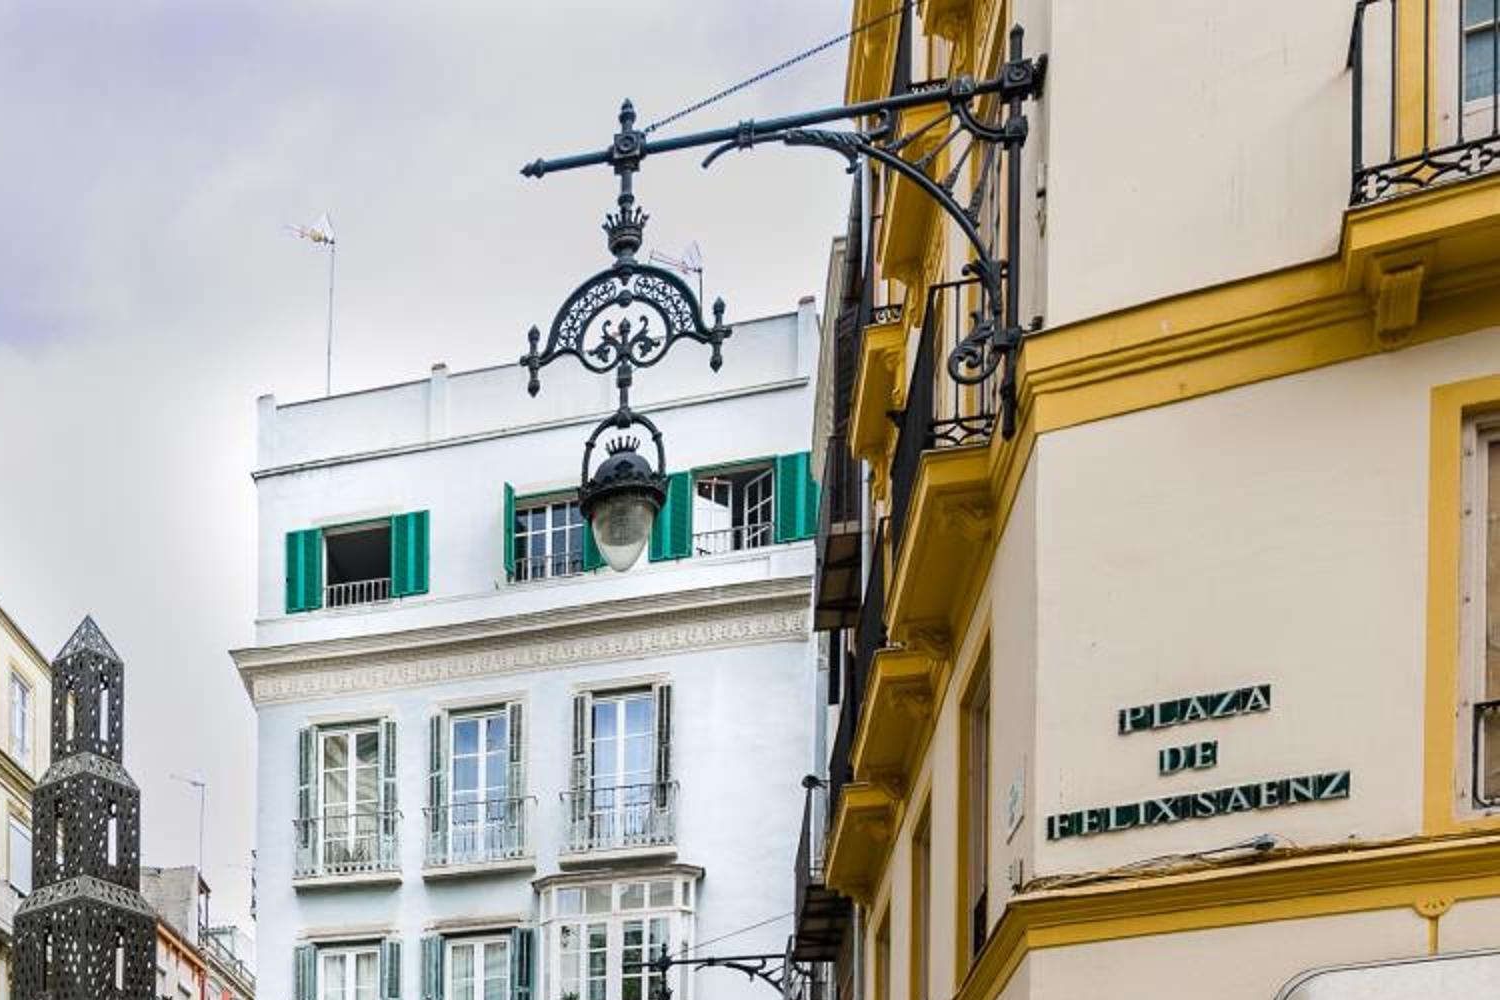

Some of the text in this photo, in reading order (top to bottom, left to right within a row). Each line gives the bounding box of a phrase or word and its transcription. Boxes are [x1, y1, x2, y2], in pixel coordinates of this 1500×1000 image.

[1123, 686, 1269, 732] PLAZA
[1161, 742, 1216, 773] DE
[1051, 772, 1349, 839] FELIX SAENZ
